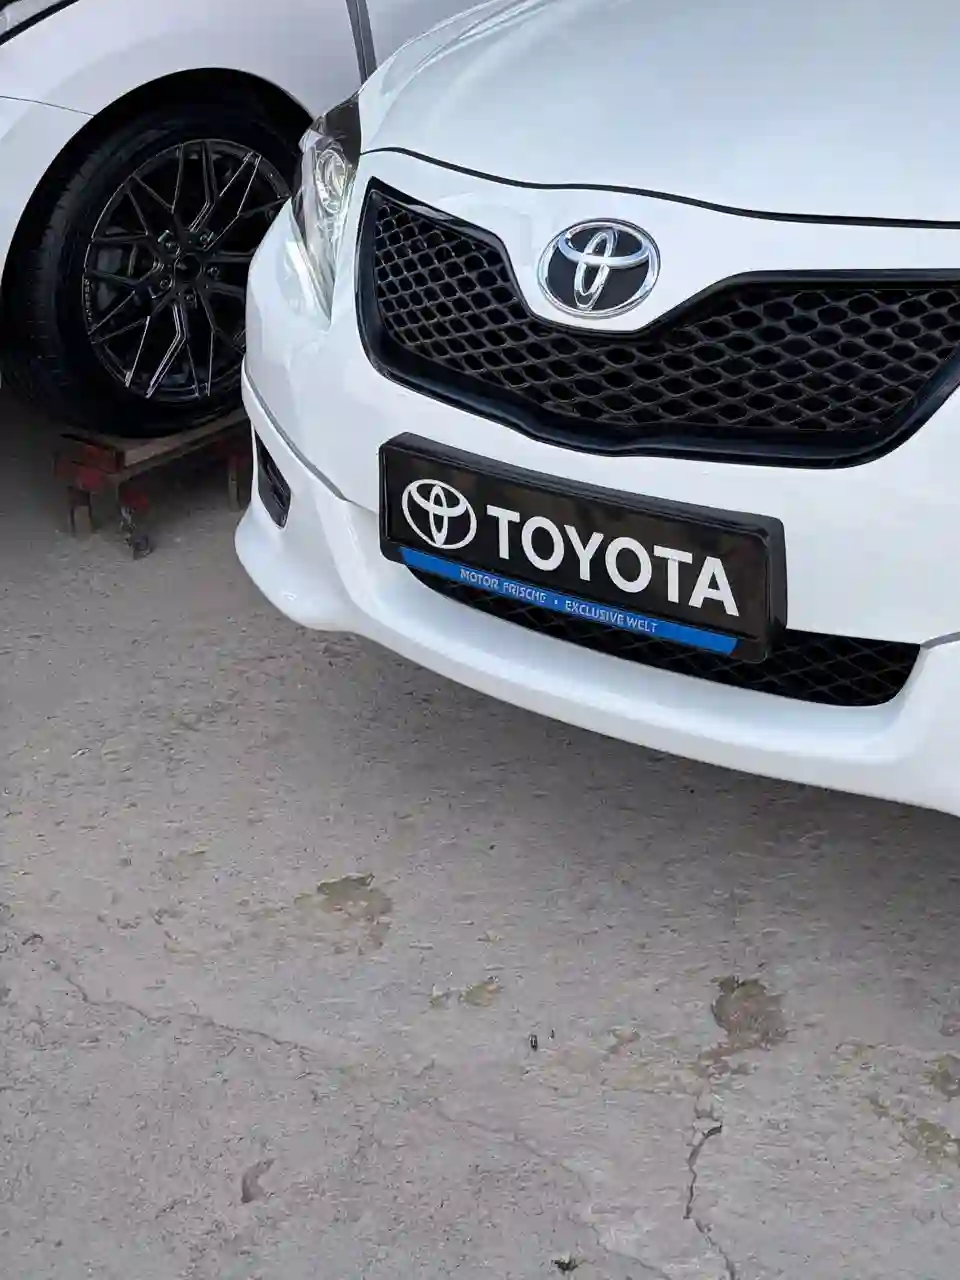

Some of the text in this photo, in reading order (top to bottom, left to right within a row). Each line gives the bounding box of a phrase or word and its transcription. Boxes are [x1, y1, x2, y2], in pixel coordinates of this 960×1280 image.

[460, 568, 499, 590] MOTOR
[564, 599, 625, 626] EXCLUSIVE
[626, 610, 658, 633] WELT
[486, 503, 740, 617] TOYOTA
